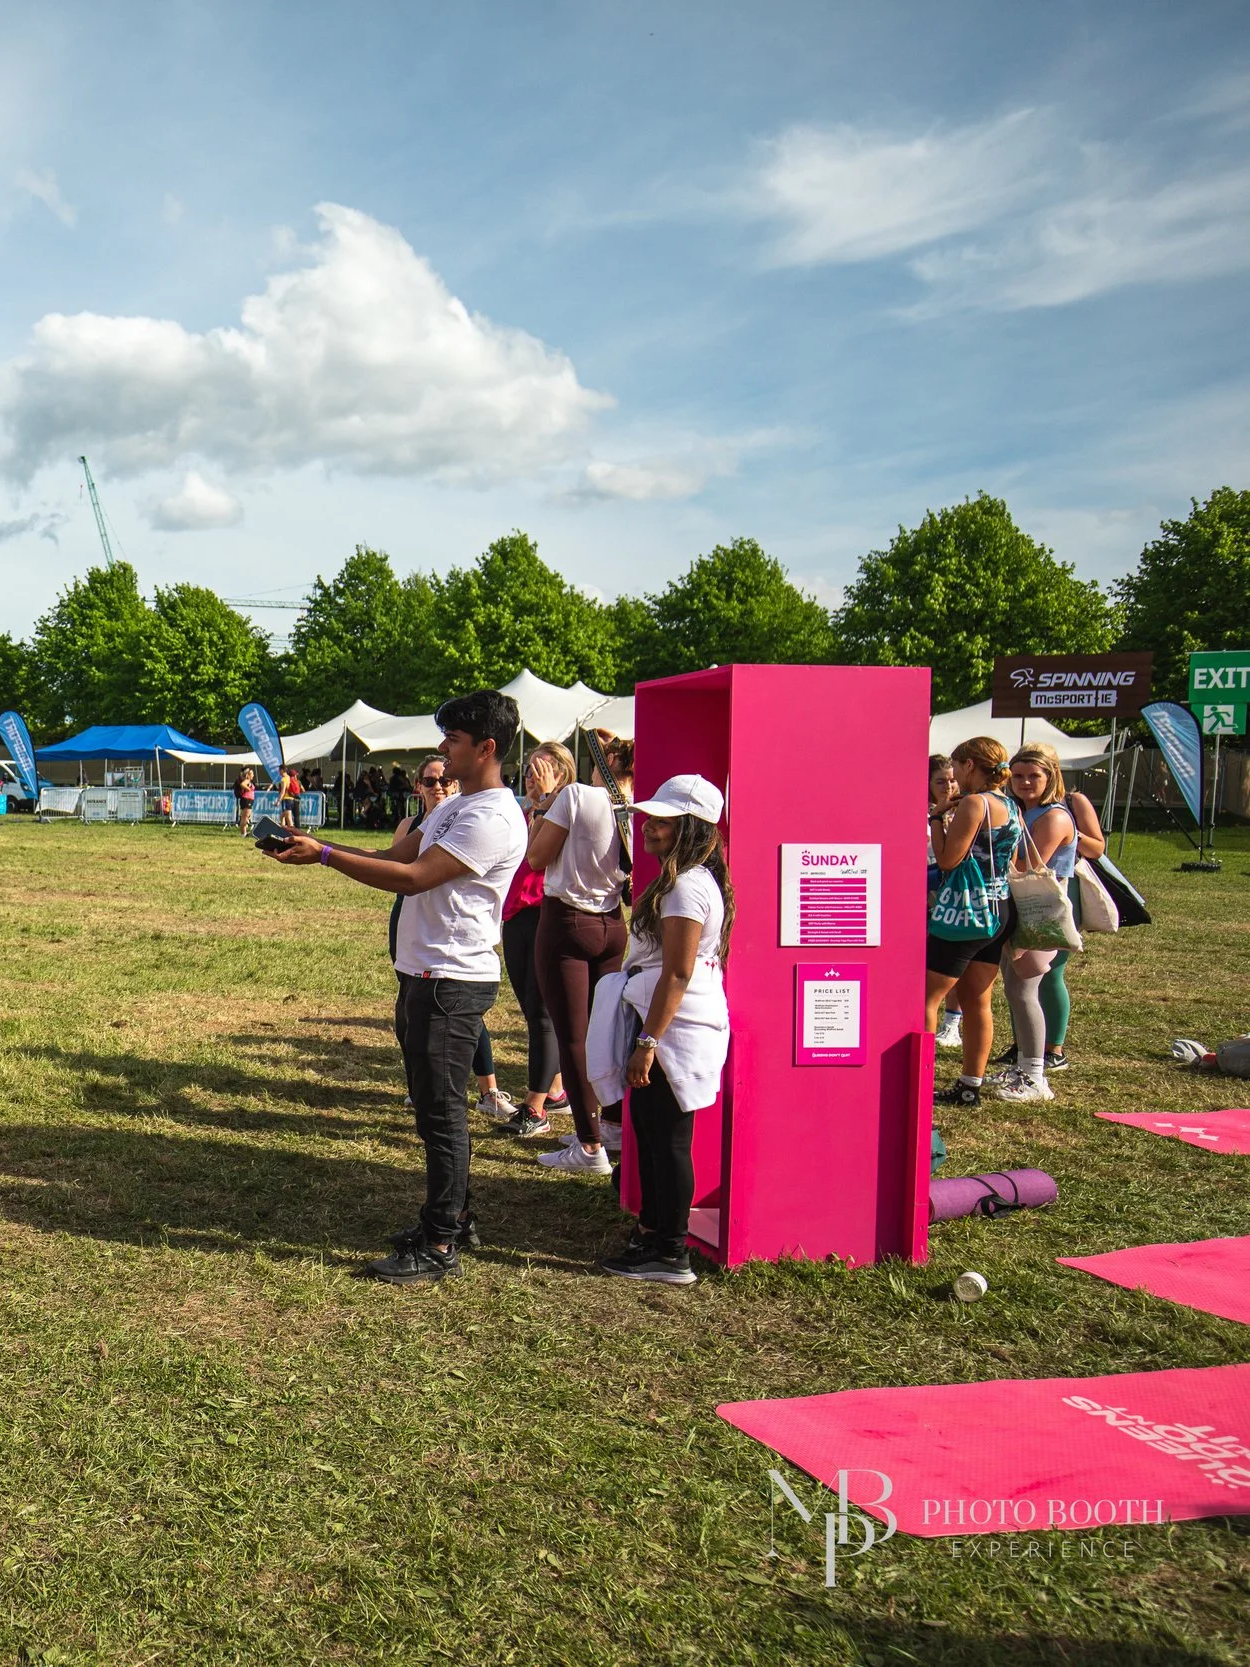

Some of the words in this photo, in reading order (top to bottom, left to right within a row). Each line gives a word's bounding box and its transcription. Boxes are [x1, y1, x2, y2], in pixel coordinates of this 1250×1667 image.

[1037, 671, 1136, 688] SPINNING
[1194, 667, 1250, 689] EXIT
[801, 855, 858, 866] SUNDAY
[1173, 1423, 1250, 1459] UIT
